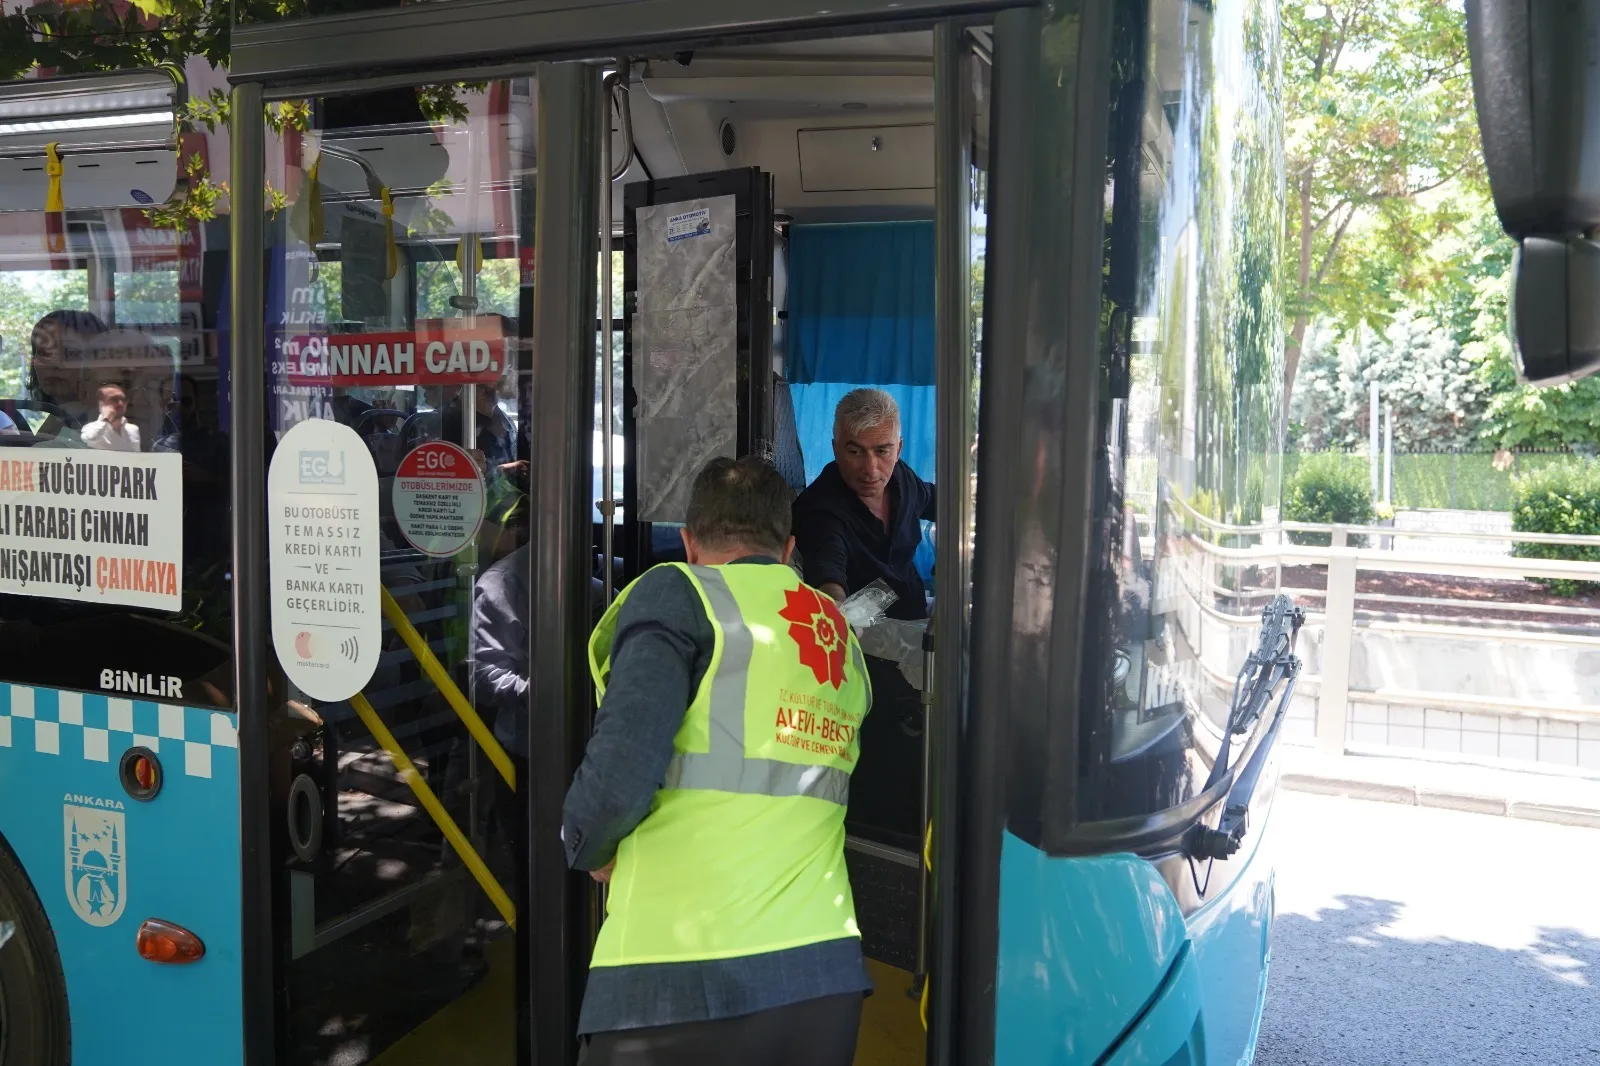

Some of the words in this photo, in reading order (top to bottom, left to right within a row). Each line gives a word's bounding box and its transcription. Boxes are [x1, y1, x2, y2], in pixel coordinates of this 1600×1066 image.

[425, 340, 498, 374] CAD.
[416, 450, 456, 470] EGO
[38, 456, 158, 500] KUĞULUPARK
[284, 506, 299, 518] BU
[302, 506, 360, 520] OTOBÜSTE
[284, 525, 360, 538] TEMASSIZ
[285, 542, 320, 555] KREDİ
[325, 544, 362, 557] KARTI
[96, 556, 178, 596] ÇANKAYA
[315, 563, 328, 574] VE
[286, 580, 326, 592] BANKA
[329, 582, 364, 596] KARTI
[286, 598, 365, 613] GEÇERLİDİR.
[800, 738, 810, 750] VE
[63, 792, 124, 810] ANKARA
